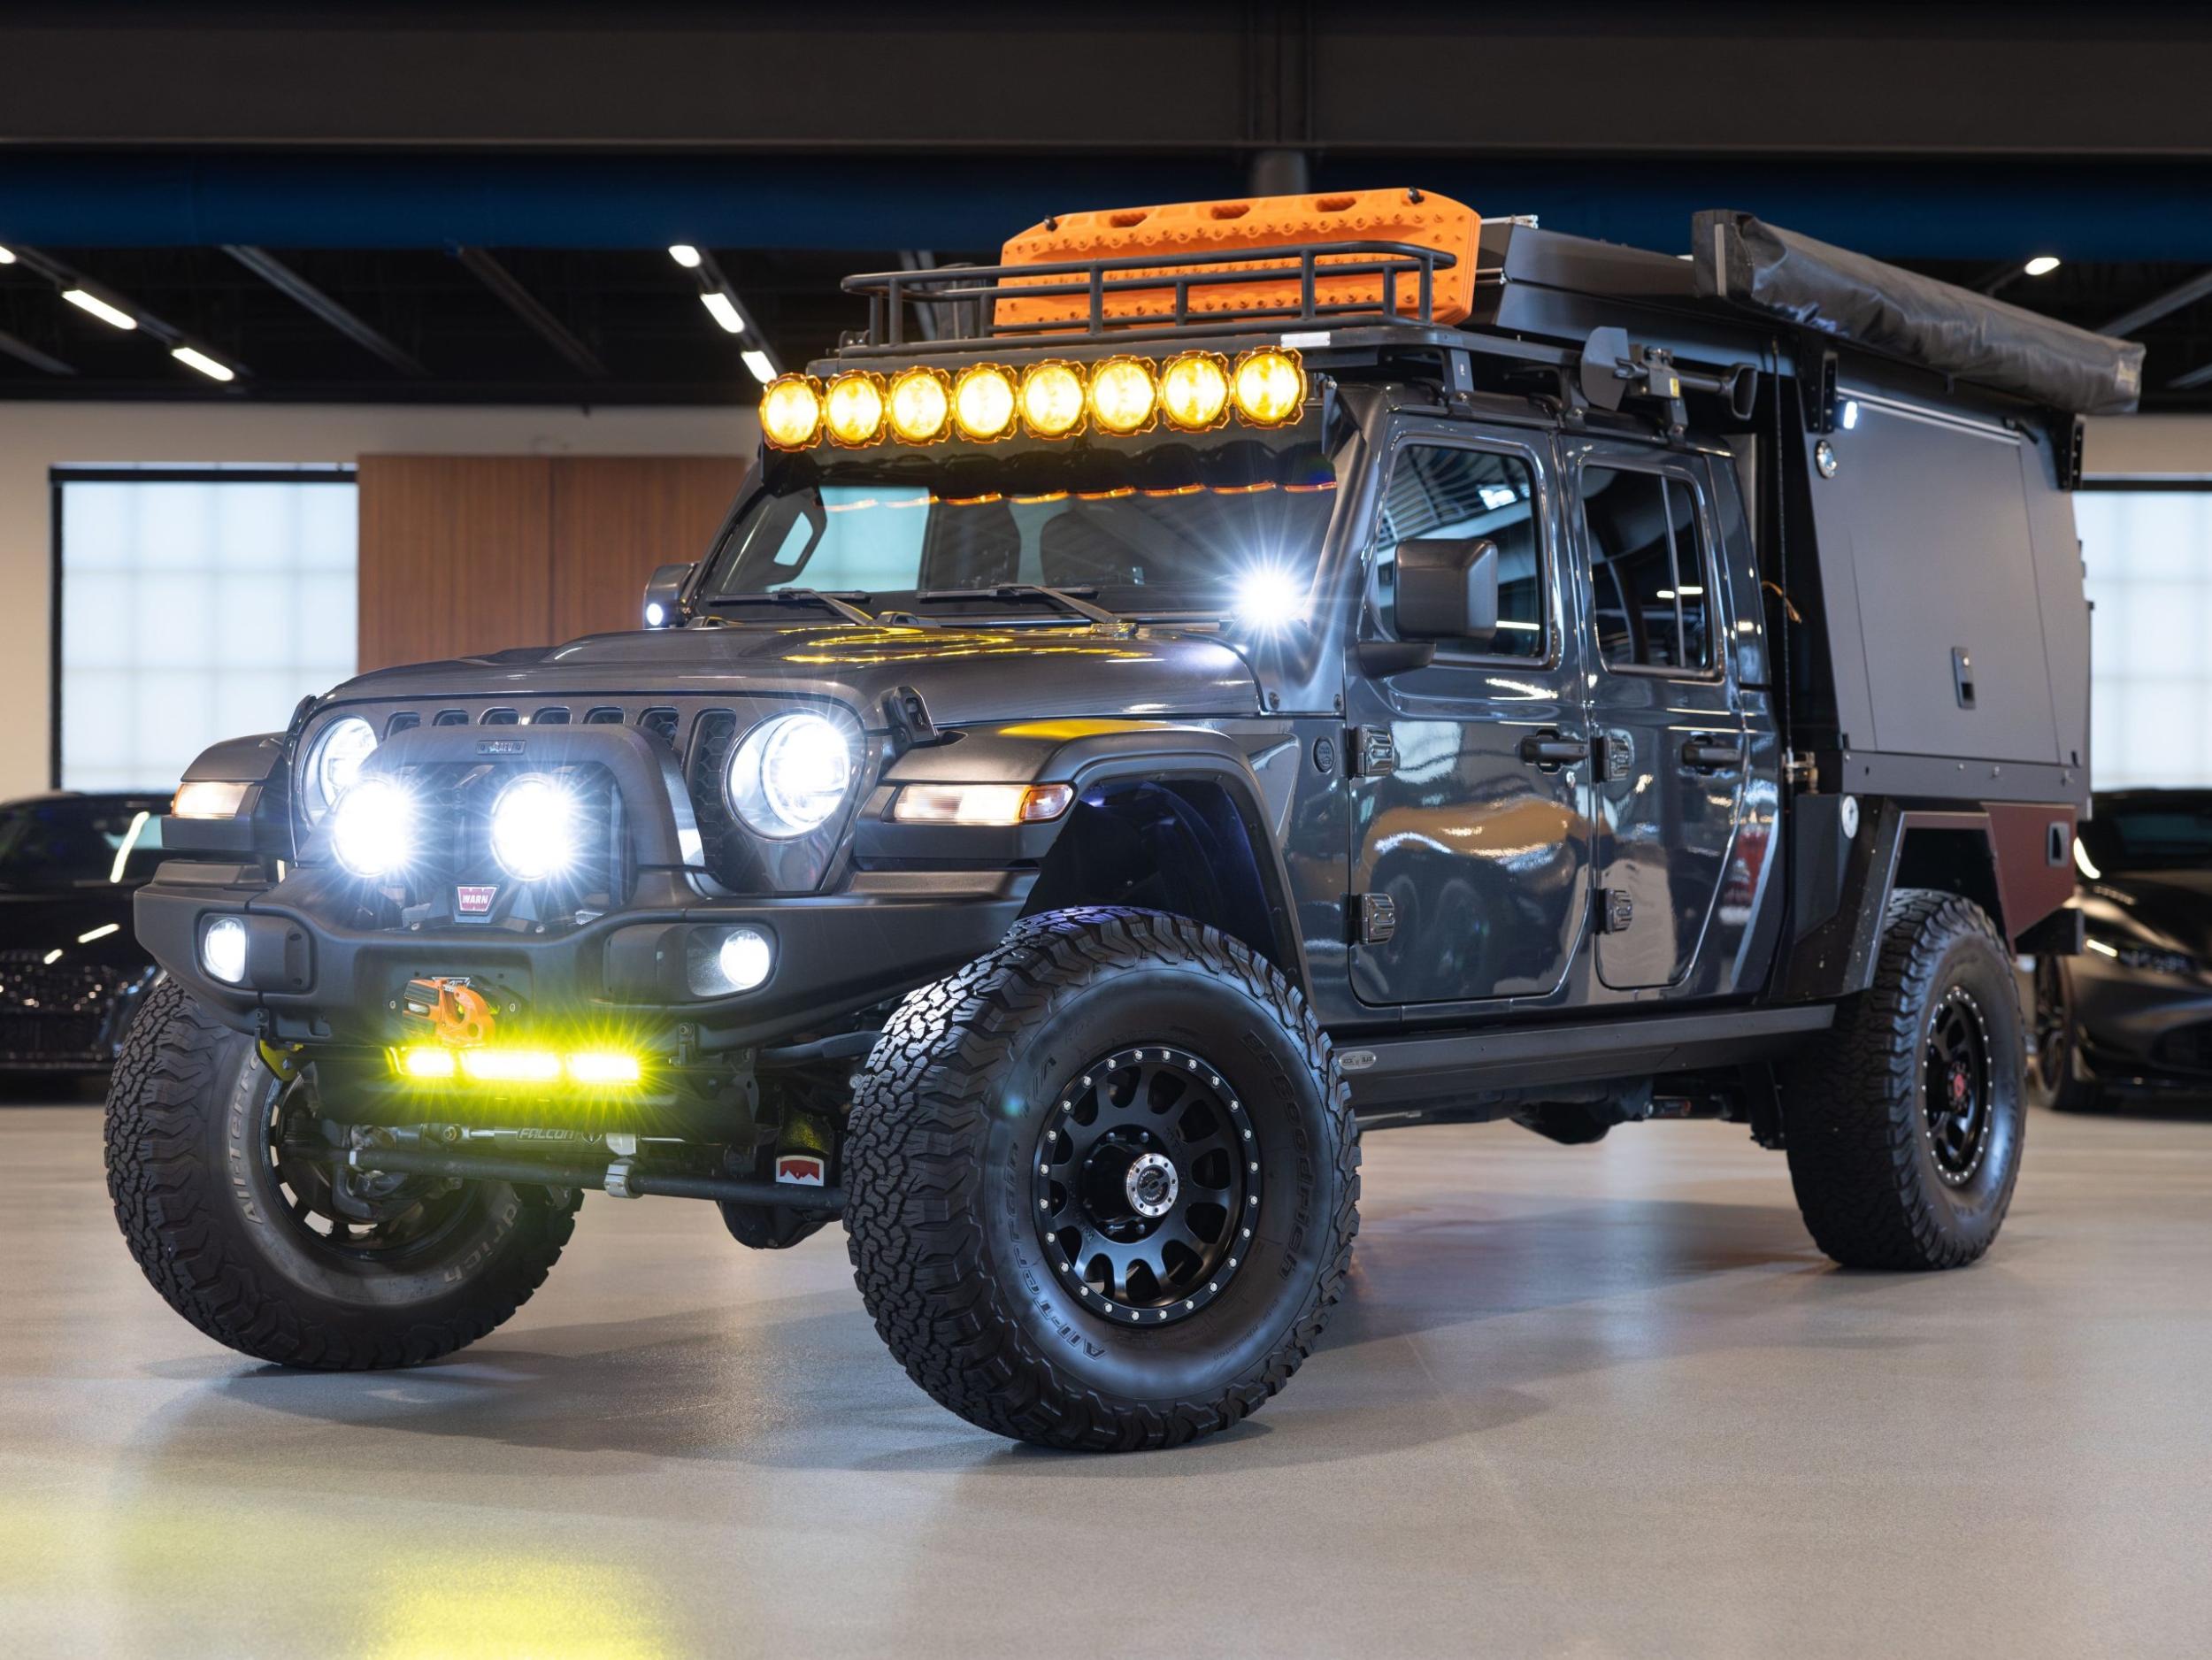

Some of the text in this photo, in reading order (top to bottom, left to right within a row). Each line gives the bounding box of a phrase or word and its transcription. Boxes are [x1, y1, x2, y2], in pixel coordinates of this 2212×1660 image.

[462, 895, 488, 903] WARN
[227, 1054, 264, 1224] All-Terra
[518, 1128, 574, 1140] FALCON
